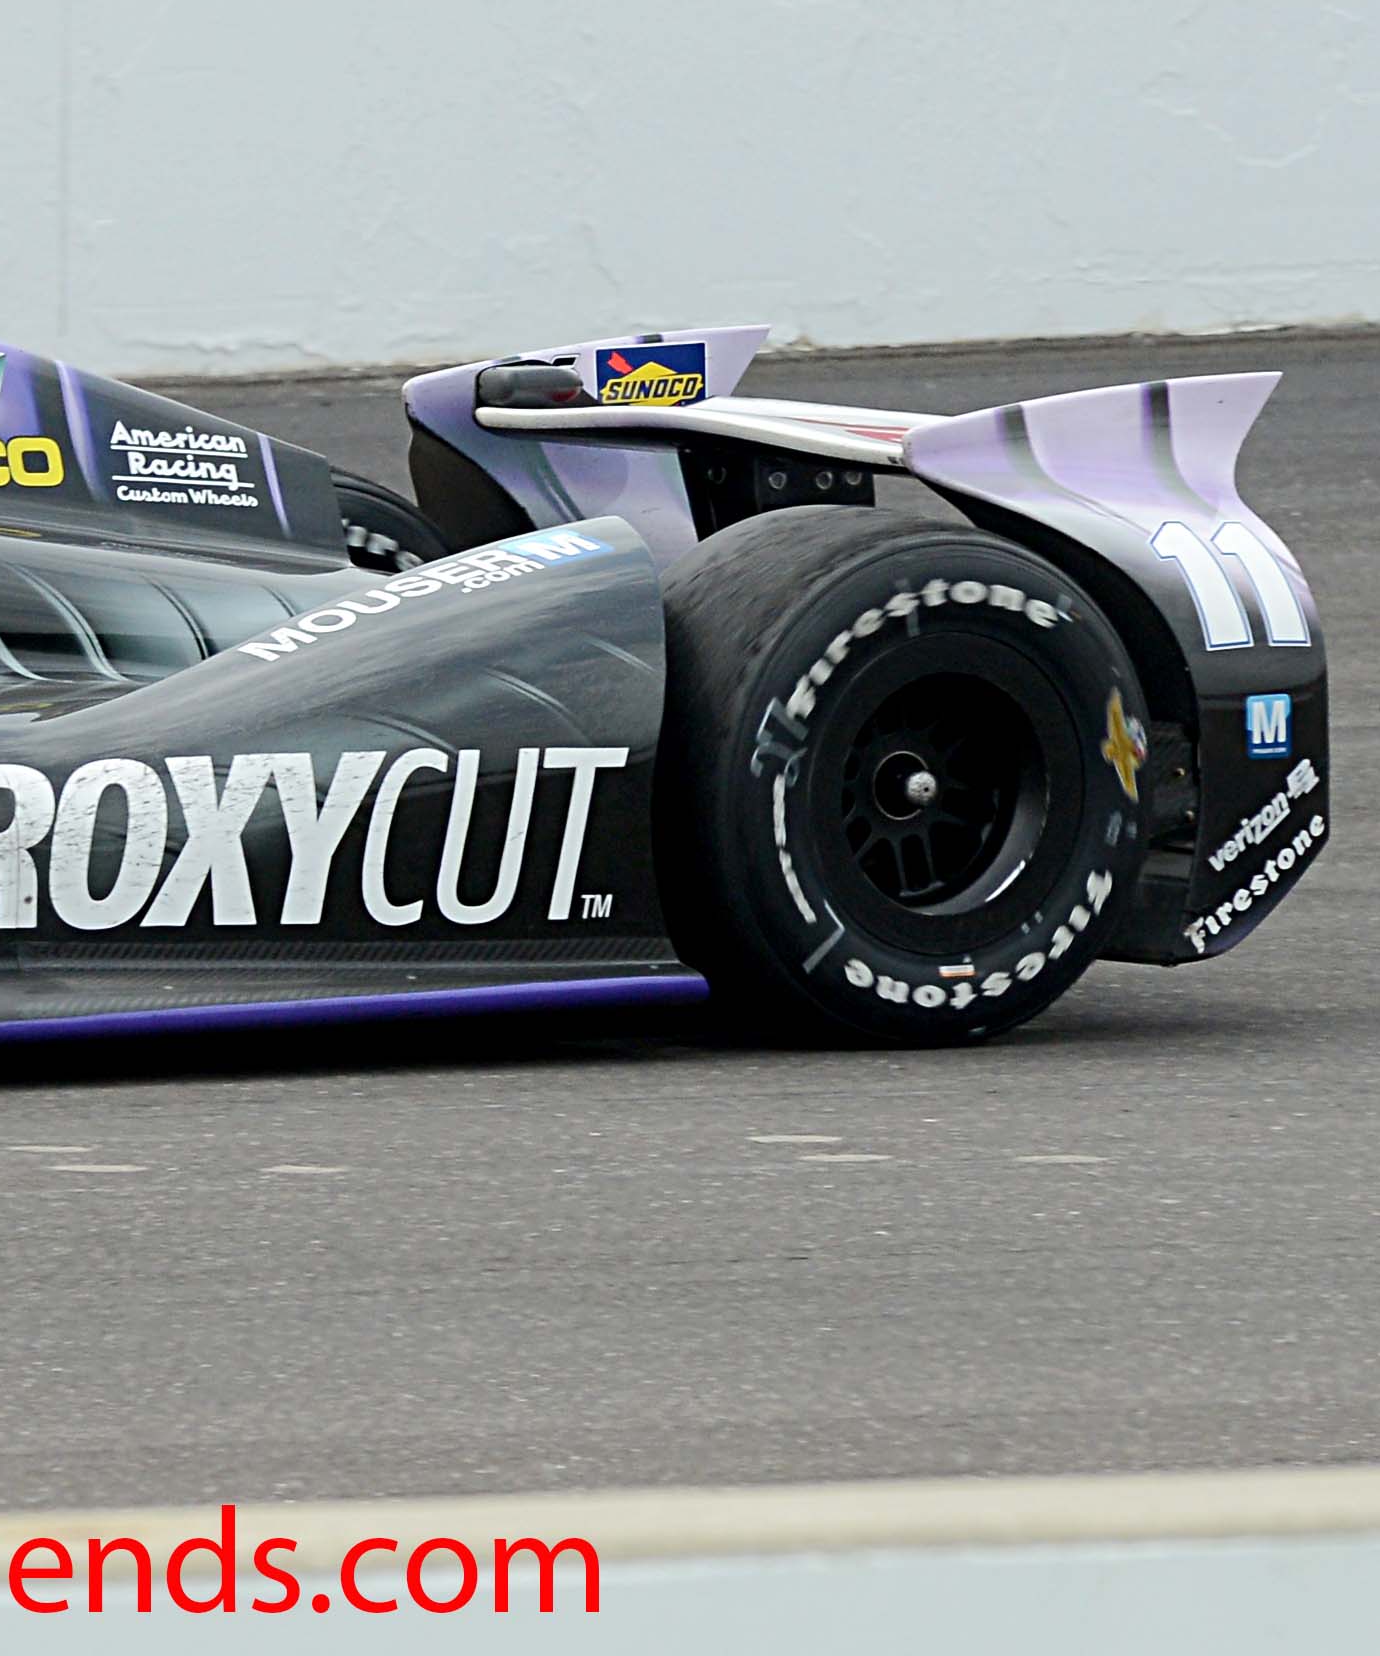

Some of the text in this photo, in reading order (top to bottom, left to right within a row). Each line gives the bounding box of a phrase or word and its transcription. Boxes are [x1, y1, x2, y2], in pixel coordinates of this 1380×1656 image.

[607, 376, 698, 402] SUNOCO
[110, 421, 247, 453] American
[130, 453, 240, 491] Racing
[116, 485, 258, 508] Custom Wheels
[462, 558, 545, 594] .com
[1149, 521, 1311, 650] 11
[239, 548, 527, 662] MOUSER
[786, 578, 1060, 718] Firestone
[1252, 700, 1286, 744] M
[1208, 792, 1291, 872] verizon
[1184, 814, 1325, 954] Firestone
[582, 894, 611, 919] TM
[844, 869, 1112, 1010] Firestone
